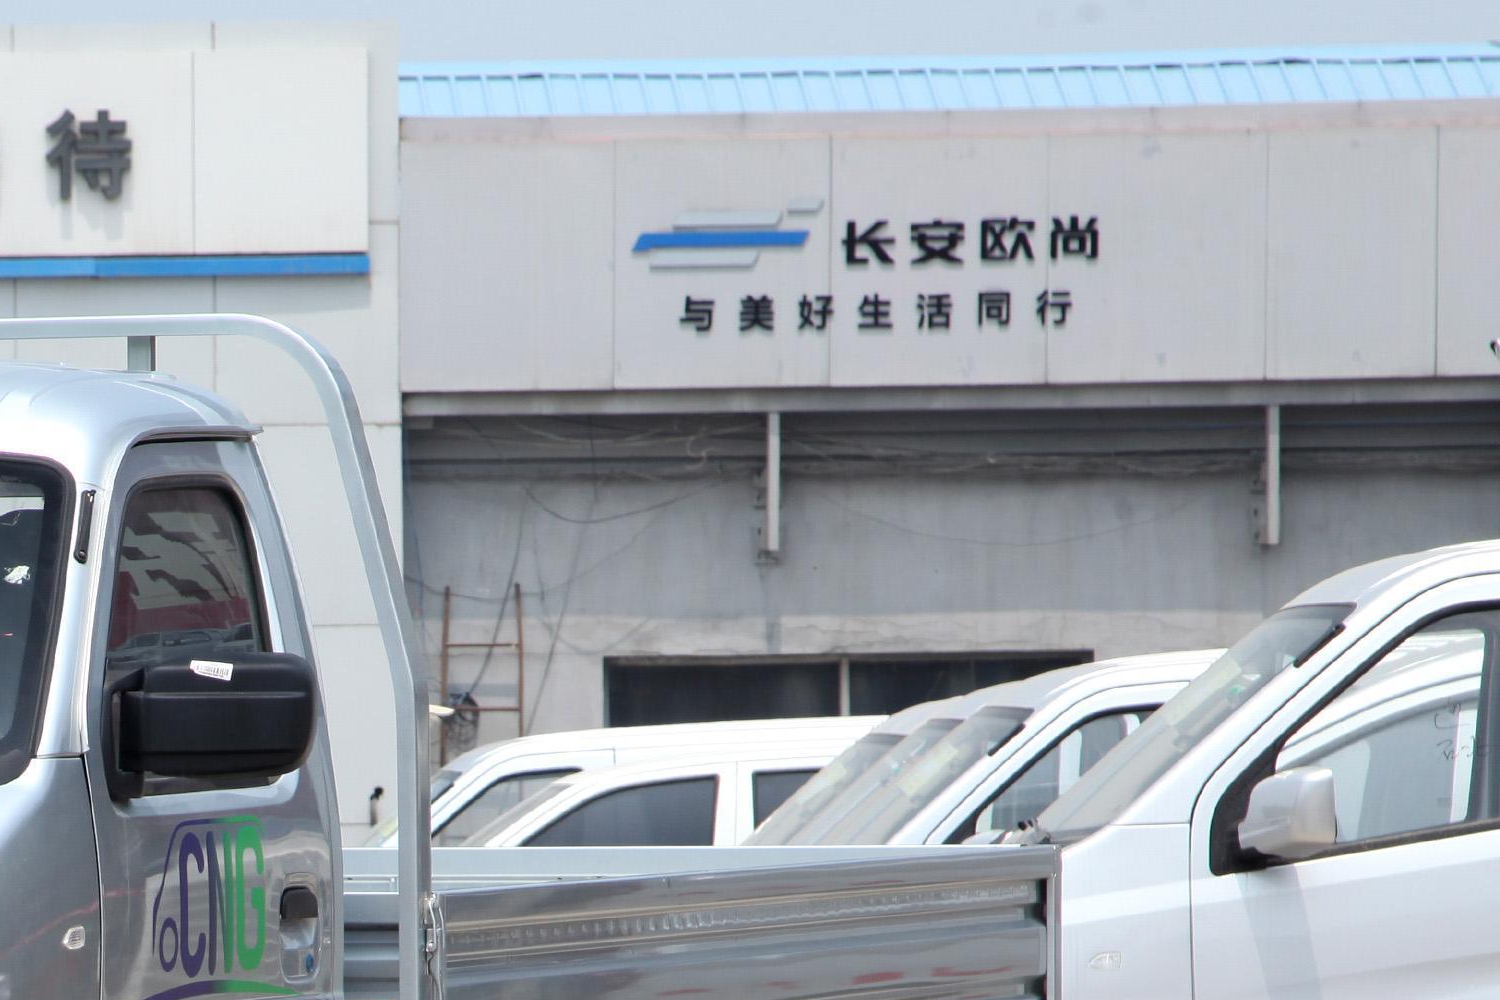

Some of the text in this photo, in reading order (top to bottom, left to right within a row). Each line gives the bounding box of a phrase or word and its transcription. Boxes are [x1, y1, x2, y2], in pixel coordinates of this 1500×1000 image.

[841, 216, 1100, 266] 长安欧尚
[679, 291, 1072, 333] 与美好生活同行
[178, 824, 266, 979] CNG
